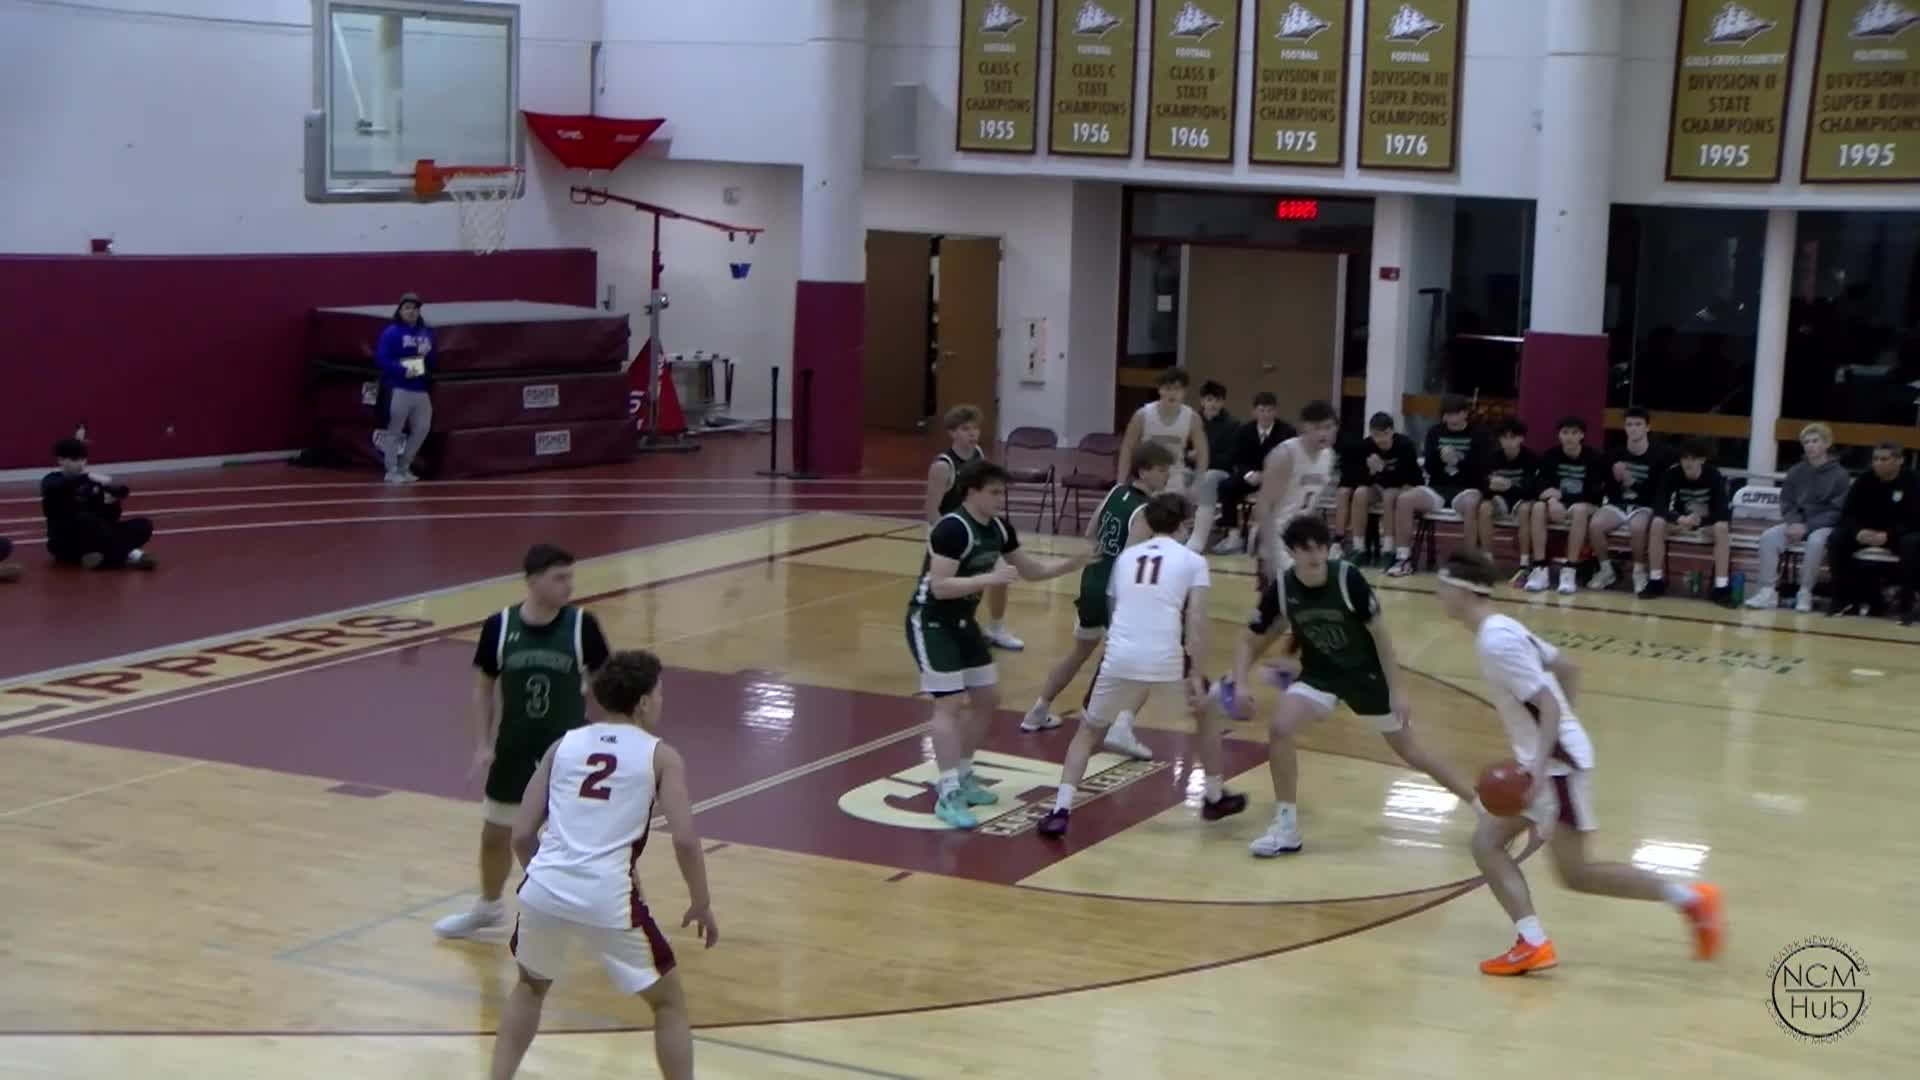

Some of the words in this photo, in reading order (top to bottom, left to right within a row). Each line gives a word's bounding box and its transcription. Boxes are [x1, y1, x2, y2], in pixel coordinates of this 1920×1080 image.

[1281, 49, 1319, 60] FOOTBALL
[1391, 51, 1430, 63] FOOTBALL
[978, 62, 1011, 76] CLASS
[1014, 62, 1021, 76] C
[1072, 63, 1104, 78] CLASS
[1108, 64, 1116, 78] C
[1169, 65, 1204, 81] CLASS
[1263, 68, 1318, 82] DIVISION
[1321, 69, 1336, 82] III
[1371, 71, 1431, 86] DIVISION
[1434, 72, 1449, 86] III
[1687, 74, 1759, 90] DIVISION
[1764, 74, 1777, 89] II
[1825, 72, 1904, 89] DIVISION
[983, 80, 1014, 94] STATE
[1077, 82, 1108, 96] STATE
[1176, 85, 1208, 100] STATE
[1260, 87, 1297, 102] SUPER
[1301, 88, 1335, 104] BOWL
[1369, 90, 1408, 105] SUPER
[1413, 91, 1447, 106] BOWL
[1822, 94, 1872, 112] SUPER
[966, 98, 1031, 113] CHAMPIONS
[1058, 101, 1127, 116] CHAMPIONS
[1155, 104, 1226, 120] CHAMPIONS
[1708, 96, 1750, 113] STATE
[1259, 105, 1336, 122] CHAMPIONS
[1369, 110, 1448, 126] CHAMPIONS
[979, 120, 1015, 139] 1955
[1072, 122, 1110, 143] 1956
[1681, 117, 1775, 135] CHAMPIONS
[1171, 126, 1209, 148] 1966
[1275, 129, 1317, 152] 1975
[1385, 133, 1428, 156] 1976
[1699, 144, 1750, 167] 1995
[1839, 143, 1896, 167] 1995
[1135, 554, 1163, 585] 11
[525, 672, 551, 719] 3
[578, 752, 618, 801] 2
